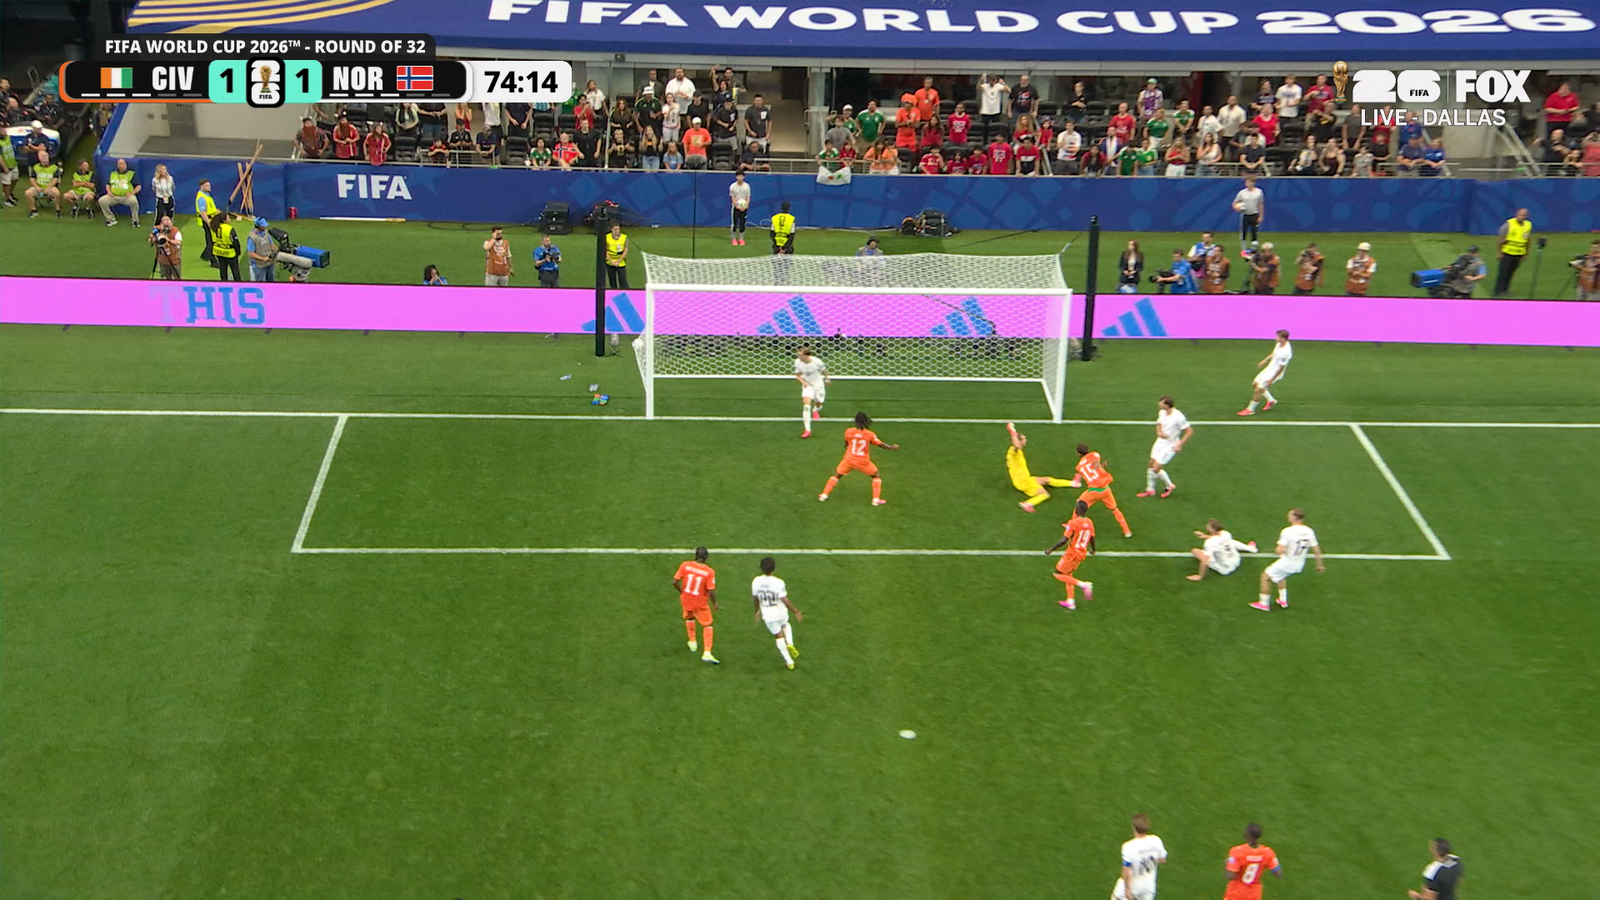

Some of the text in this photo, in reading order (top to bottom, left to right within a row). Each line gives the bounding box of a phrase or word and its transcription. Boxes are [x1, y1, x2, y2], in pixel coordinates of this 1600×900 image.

[488, 0, 1598, 35] FIFA WORLD CUP 2026
[337, 173, 413, 200] FIFA
[149, 285, 265, 325] THIS
[851, 438, 867, 456] 12
[1080, 462, 1099, 482] 15
[683, 573, 704, 596] 11
[1242, 863, 1259, 884] 8
